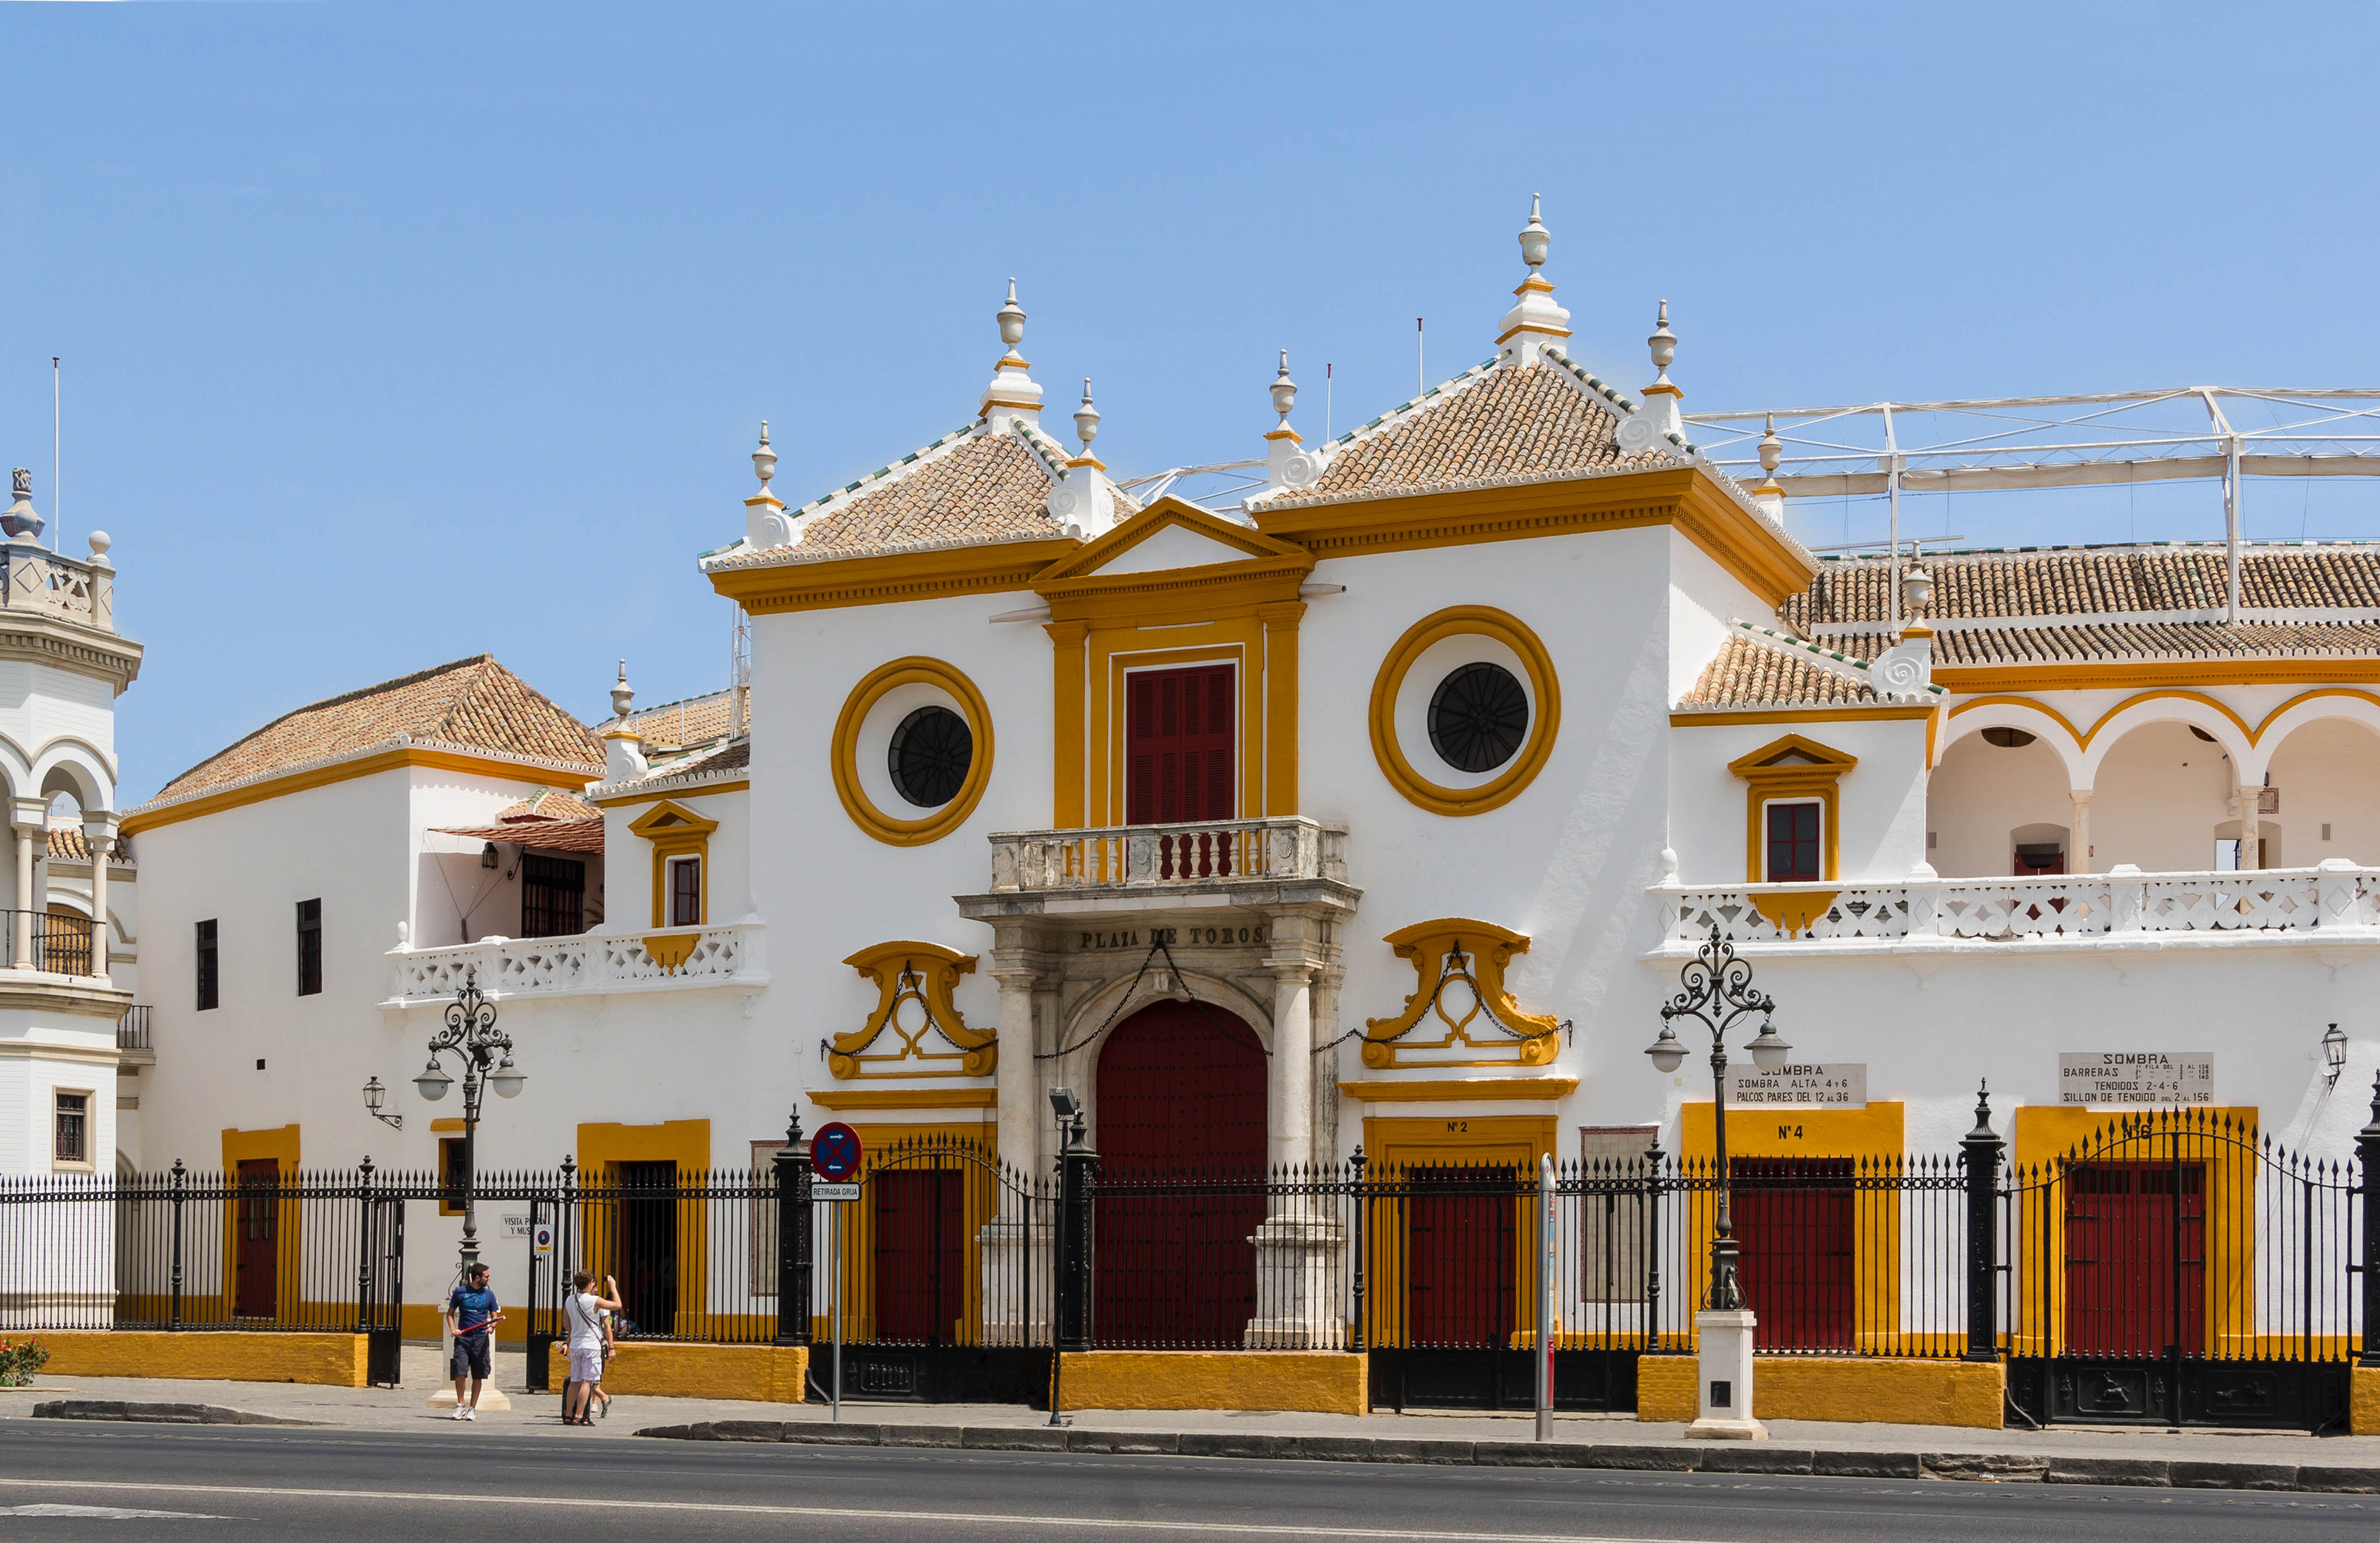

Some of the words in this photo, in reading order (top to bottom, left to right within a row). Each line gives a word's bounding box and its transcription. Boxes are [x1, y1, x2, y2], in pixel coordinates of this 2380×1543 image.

[1081, 930, 1139, 948] PLAZA
[1150, 928, 1177, 944] DE
[1190, 927, 1263, 945] TOROS
[2103, 1054, 2168, 1064] SOMBRA
[2063, 1068, 2118, 1077] BARRERAS
[1738, 1079, 1779, 1088] SOMBRA
[1791, 1079, 1817, 1088] ALTA
[1826, 1079, 1832, 1088] 4
[1842, 1079, 1847, 1088] 6
[2095, 1081, 2139, 1090] TENDIDOS
[1737, 1092, 1763, 1102] PALCOS
[1768, 1092, 1793, 1102] PARES
[1796, 1092, 1811, 1102] DEL
[1816, 1092, 1824, 1102] 12
[1836, 1092, 1848, 1102] 36
[2063, 1093, 2097, 1101] SILLON
[2101, 1093, 2112, 1101] DE
[2117, 1093, 2156, 1101] TENDIDO
[2174, 1093, 2180, 1101] 2
[2194, 1093, 2209, 1101] 156
[1461, 1121, 1467, 1132] 2
[2141, 1124, 2151, 1139] 6
[1794, 1125, 1803, 1139] 4
